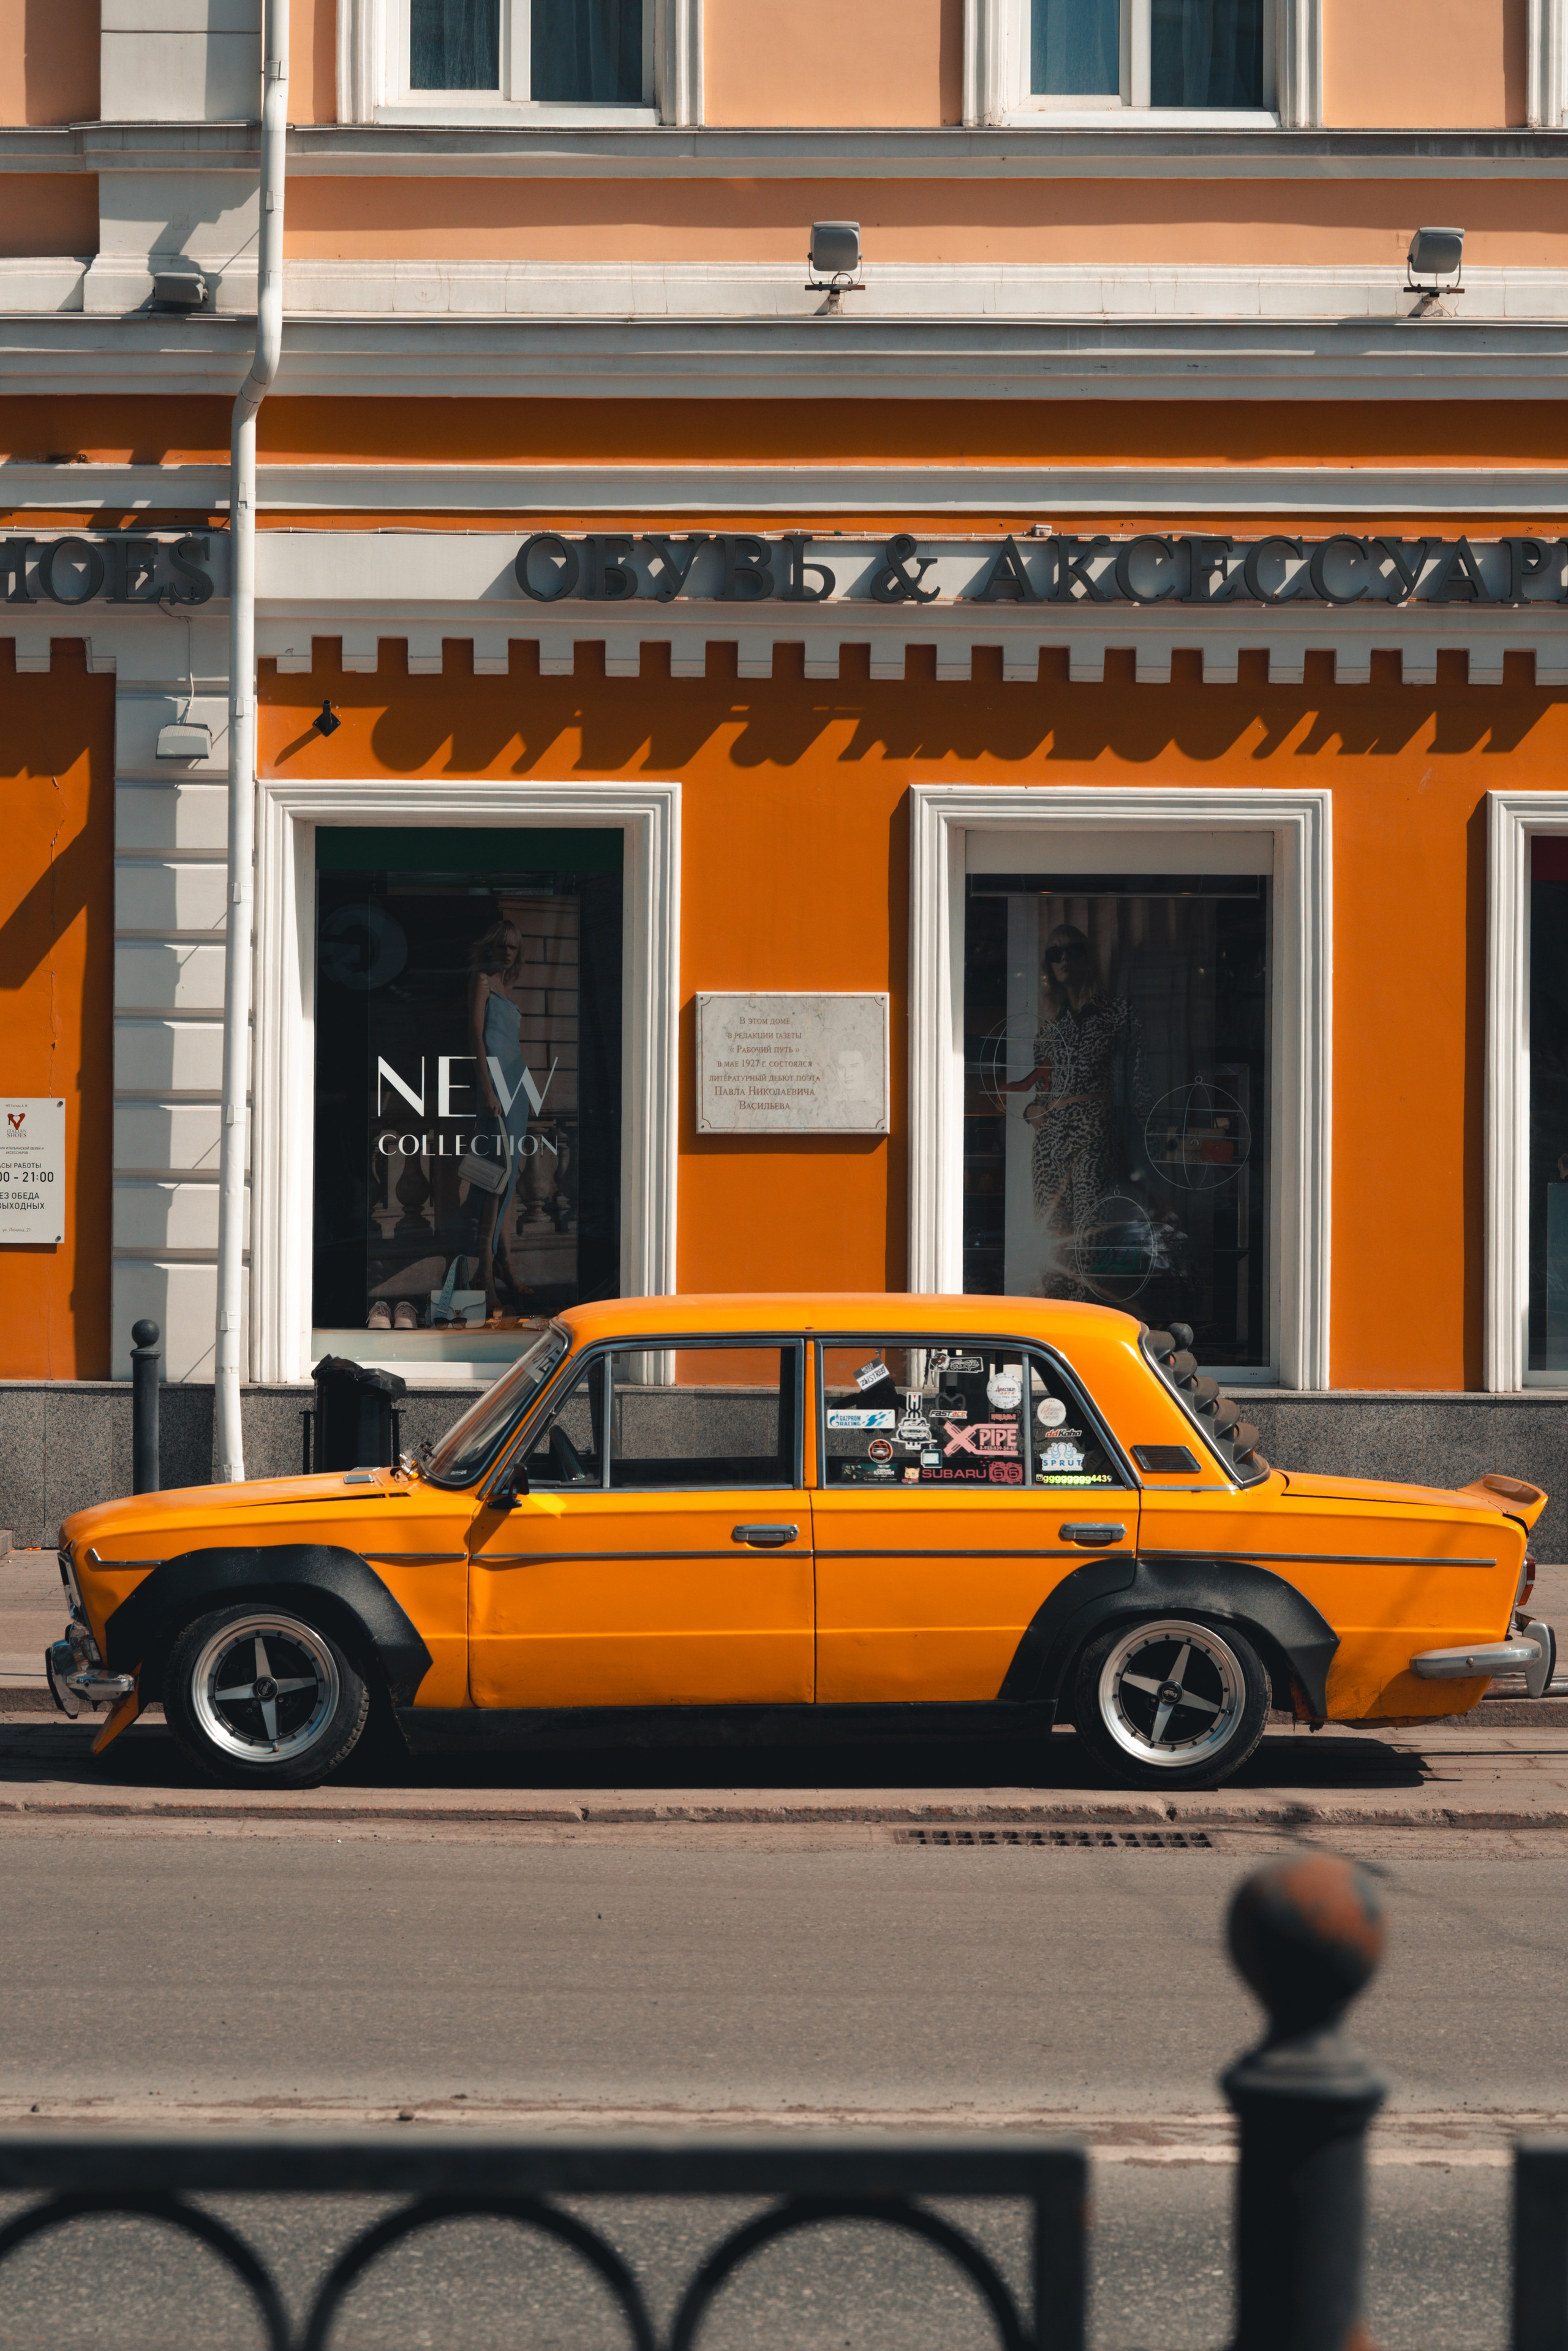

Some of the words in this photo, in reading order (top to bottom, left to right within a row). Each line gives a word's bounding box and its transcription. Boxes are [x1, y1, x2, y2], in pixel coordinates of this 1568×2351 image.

[515, 532, 835, 602] ОБУВЬ
[870, 534, 940, 603] &
[976, 534, 1568, 604] АКСЕССУАР
[378, 1056, 558, 1117] NEW
[379, 1134, 558, 1156] COLLECTION
[23, 1171, 54, 1182] 21:00
[922, 1469, 987, 1478] SUBARU
